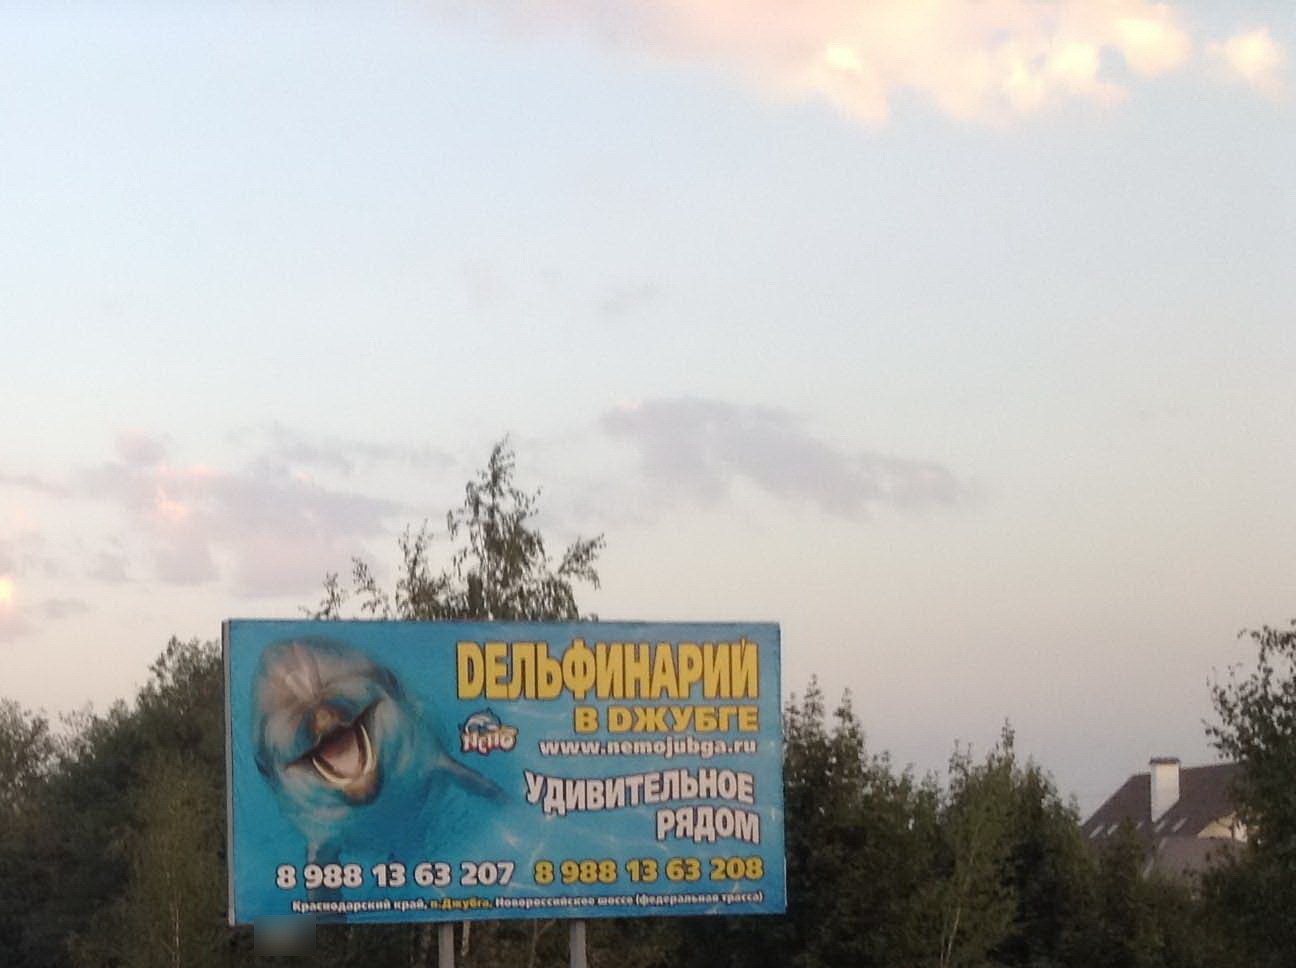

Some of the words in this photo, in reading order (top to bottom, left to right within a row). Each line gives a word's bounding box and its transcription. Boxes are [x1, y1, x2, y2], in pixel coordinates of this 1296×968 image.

[574, 706, 600, 733] В
[539, 736, 758, 759] www.nemojubga.ru
[524, 768, 755, 817] УДИВИТЕЛЬНОЕ
[656, 806, 761, 845] РЯДОМ
[276, 864, 296, 889] 8
[304, 863, 363, 889] 988
[372, 862, 405, 887] 13
[414, 861, 452, 887] 63
[461, 860, 515, 886] 207
[534, 859, 554, 885] 8
[560, 859, 617, 885] 988
[626, 858, 658, 883] 13
[666, 857, 702, 882] 63
[710, 855, 764, 881] 208
[292, 898, 391, 913] Краснодарский
